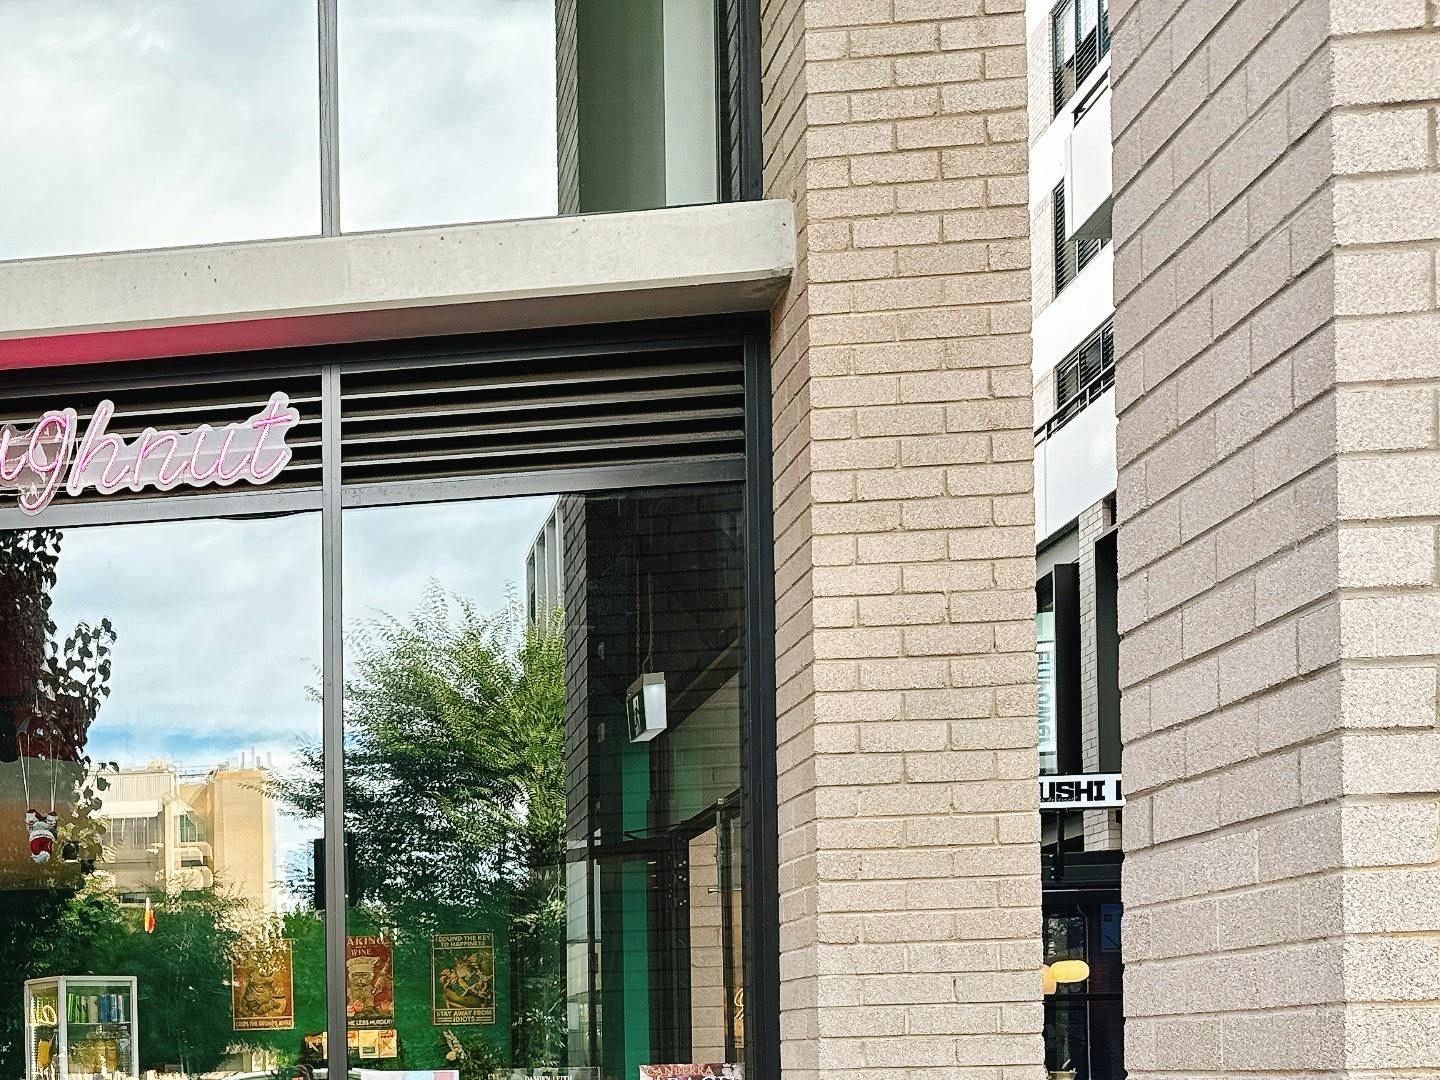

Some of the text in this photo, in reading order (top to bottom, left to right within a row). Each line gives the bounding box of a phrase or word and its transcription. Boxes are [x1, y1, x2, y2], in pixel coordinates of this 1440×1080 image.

[1040, 780, 1105, 802] USHI
[346, 937, 385, 946] AKING
[646, 1066, 714, 1076] CANBERRA
